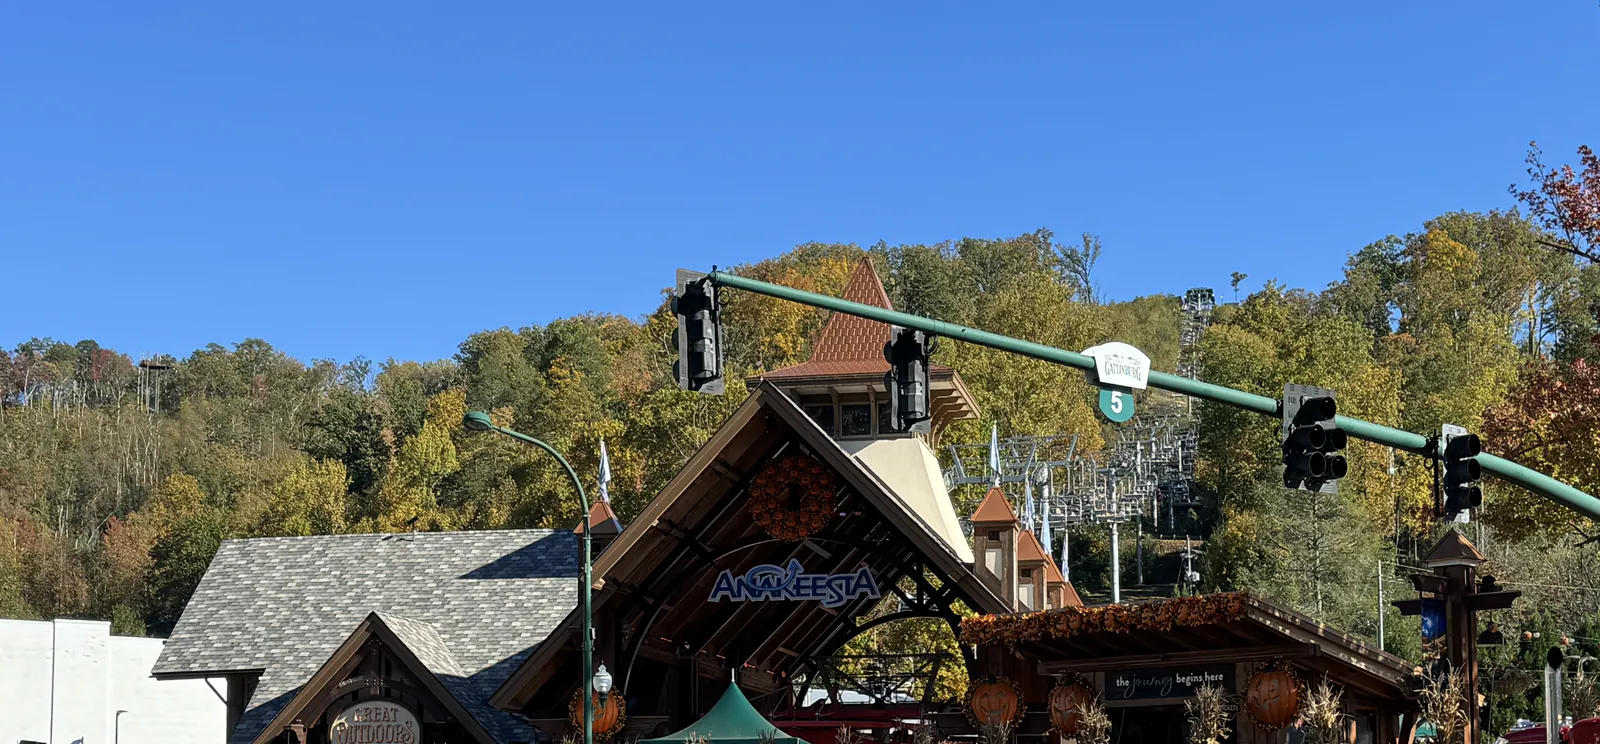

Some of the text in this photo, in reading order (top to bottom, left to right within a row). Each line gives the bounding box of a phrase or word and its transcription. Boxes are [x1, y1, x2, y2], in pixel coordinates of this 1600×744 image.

[1105, 361, 1141, 381] GATLINBURG
[1111, 391, 1123, 413] 5
[708, 562, 880, 608] ANAKEESTA
[1116, 672, 1224, 699] the journey begins here
[354, 707, 399, 722] GREAT
[337, 721, 415, 744] OUTDOORS
